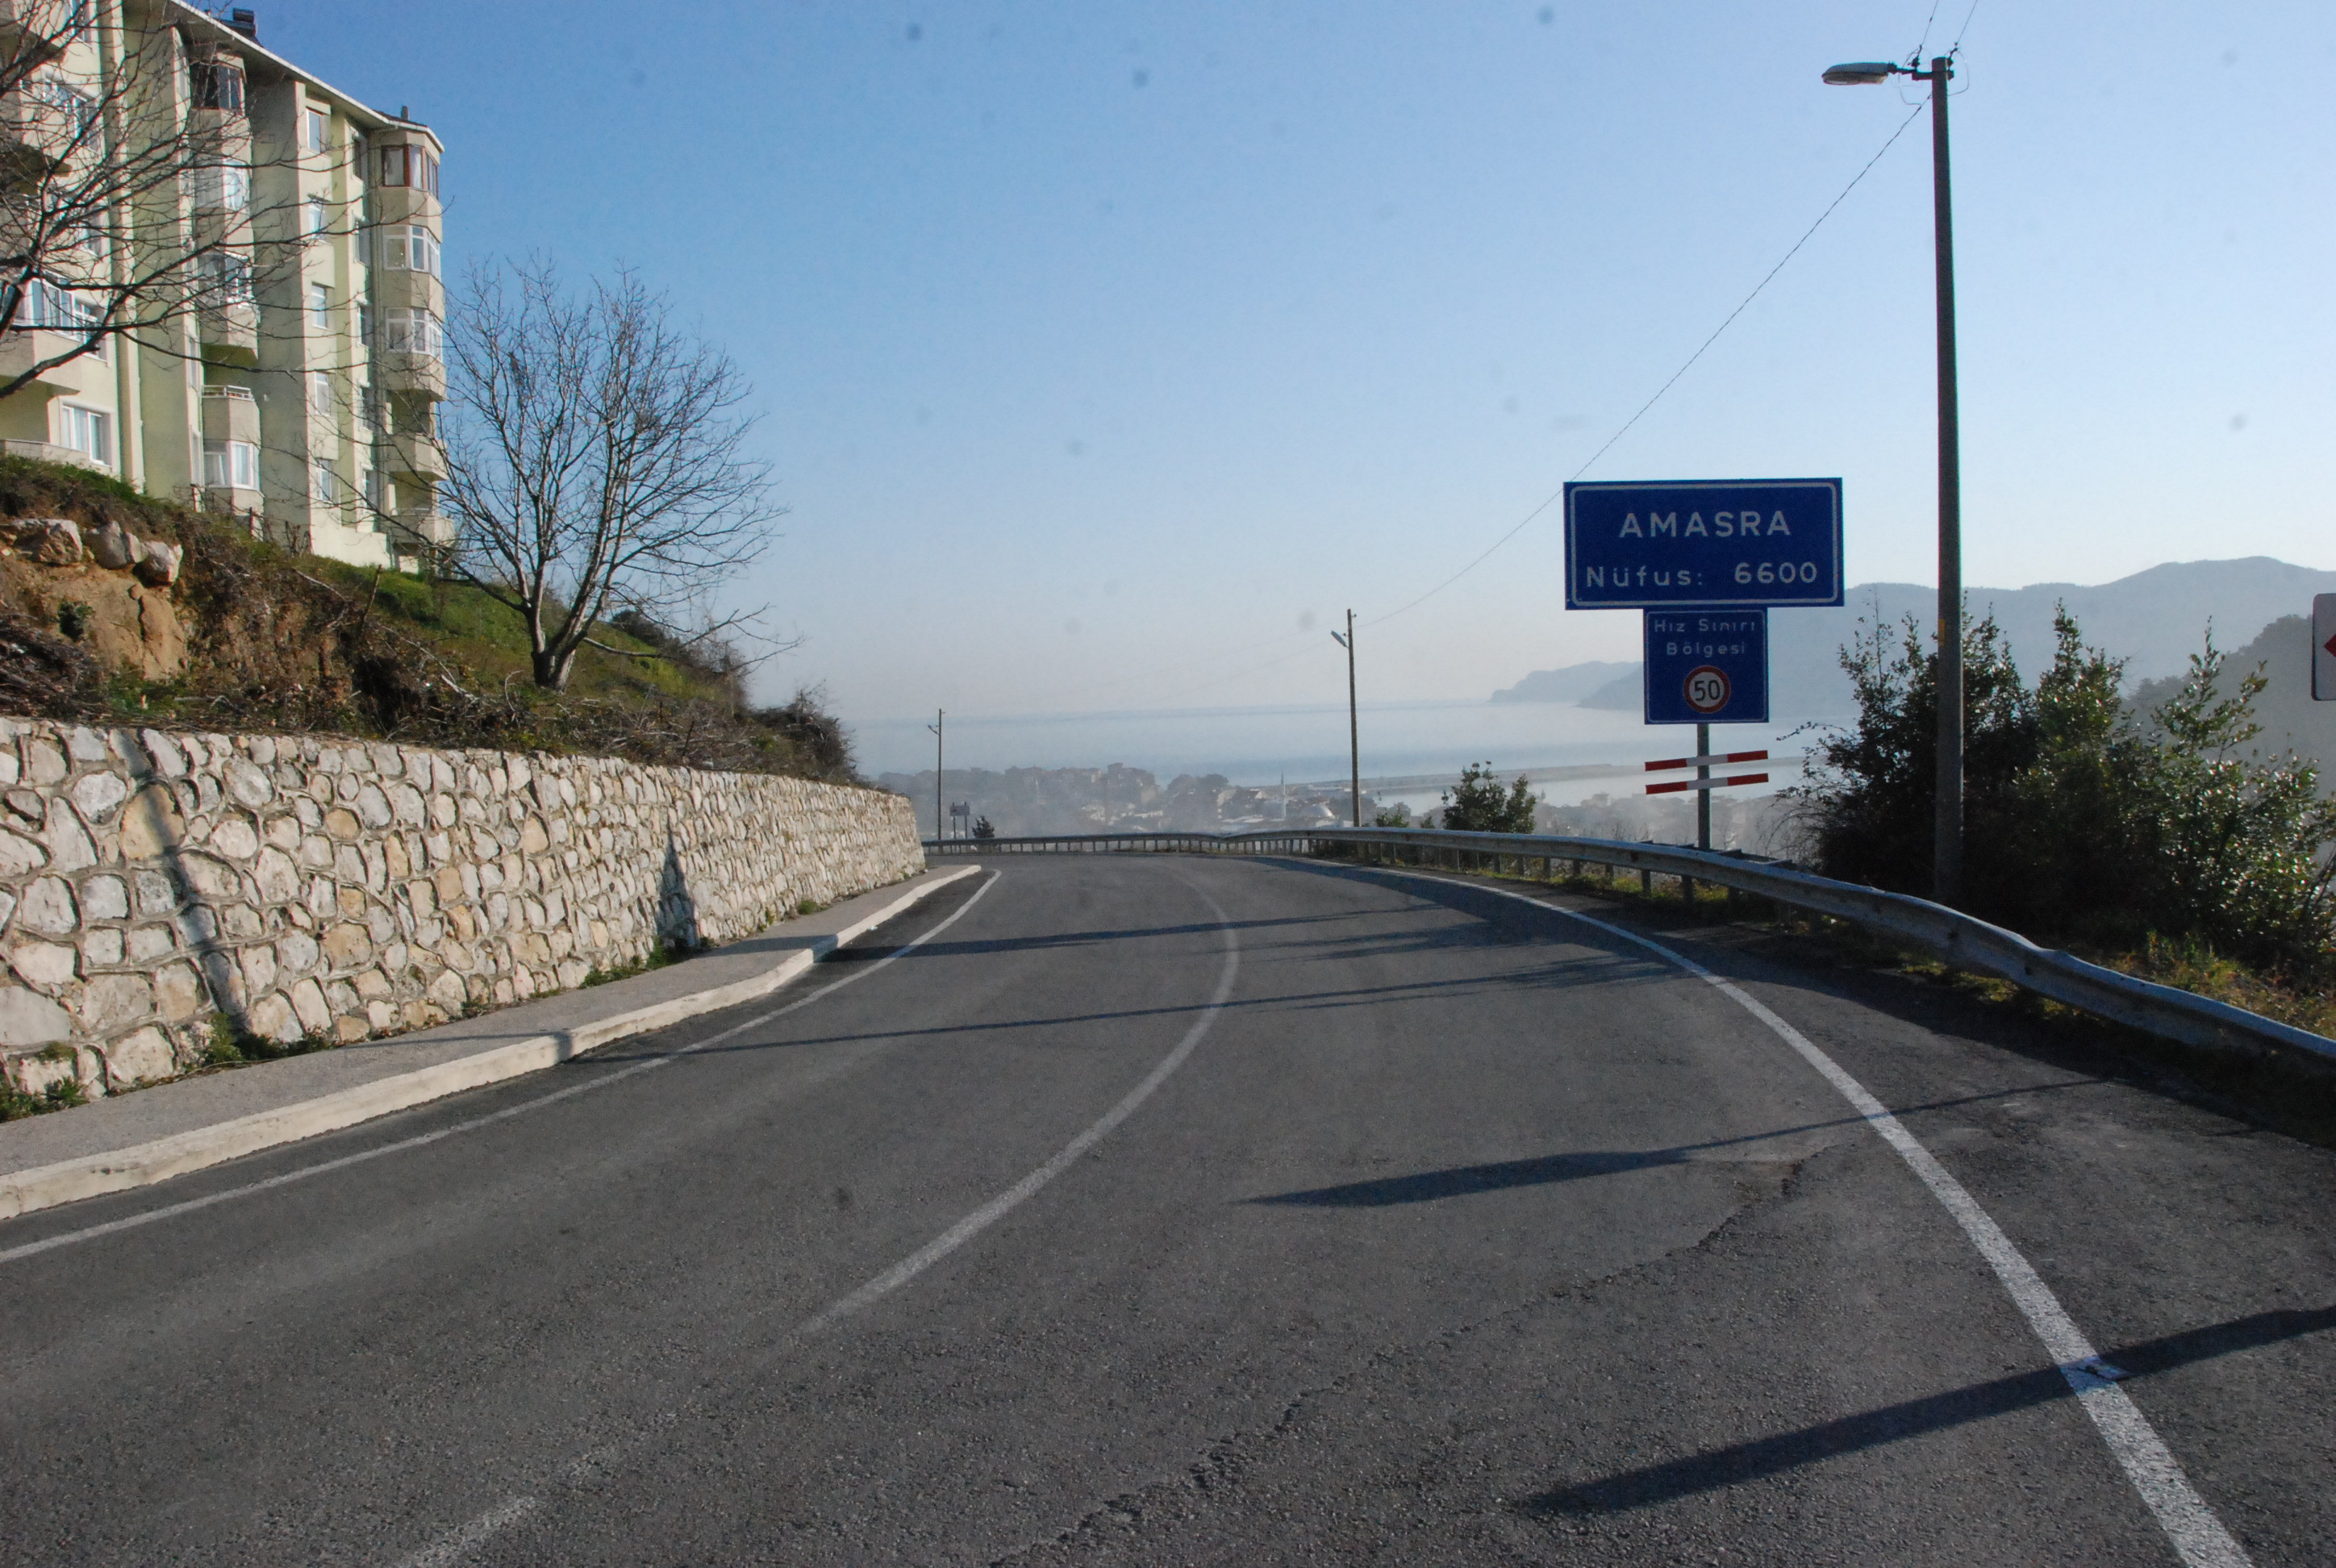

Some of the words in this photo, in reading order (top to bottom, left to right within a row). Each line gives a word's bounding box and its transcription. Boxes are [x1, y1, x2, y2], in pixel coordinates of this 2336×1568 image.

[1618, 511, 1791, 538] AMASRA
[1586, 565, 1703, 587] Nüfus:
[1734, 561, 1817, 584] 6600
[1654, 619, 1685, 633] Hız
[1666, 642, 1746, 658] Bölgesi
[1694, 680, 1721, 702] 50
